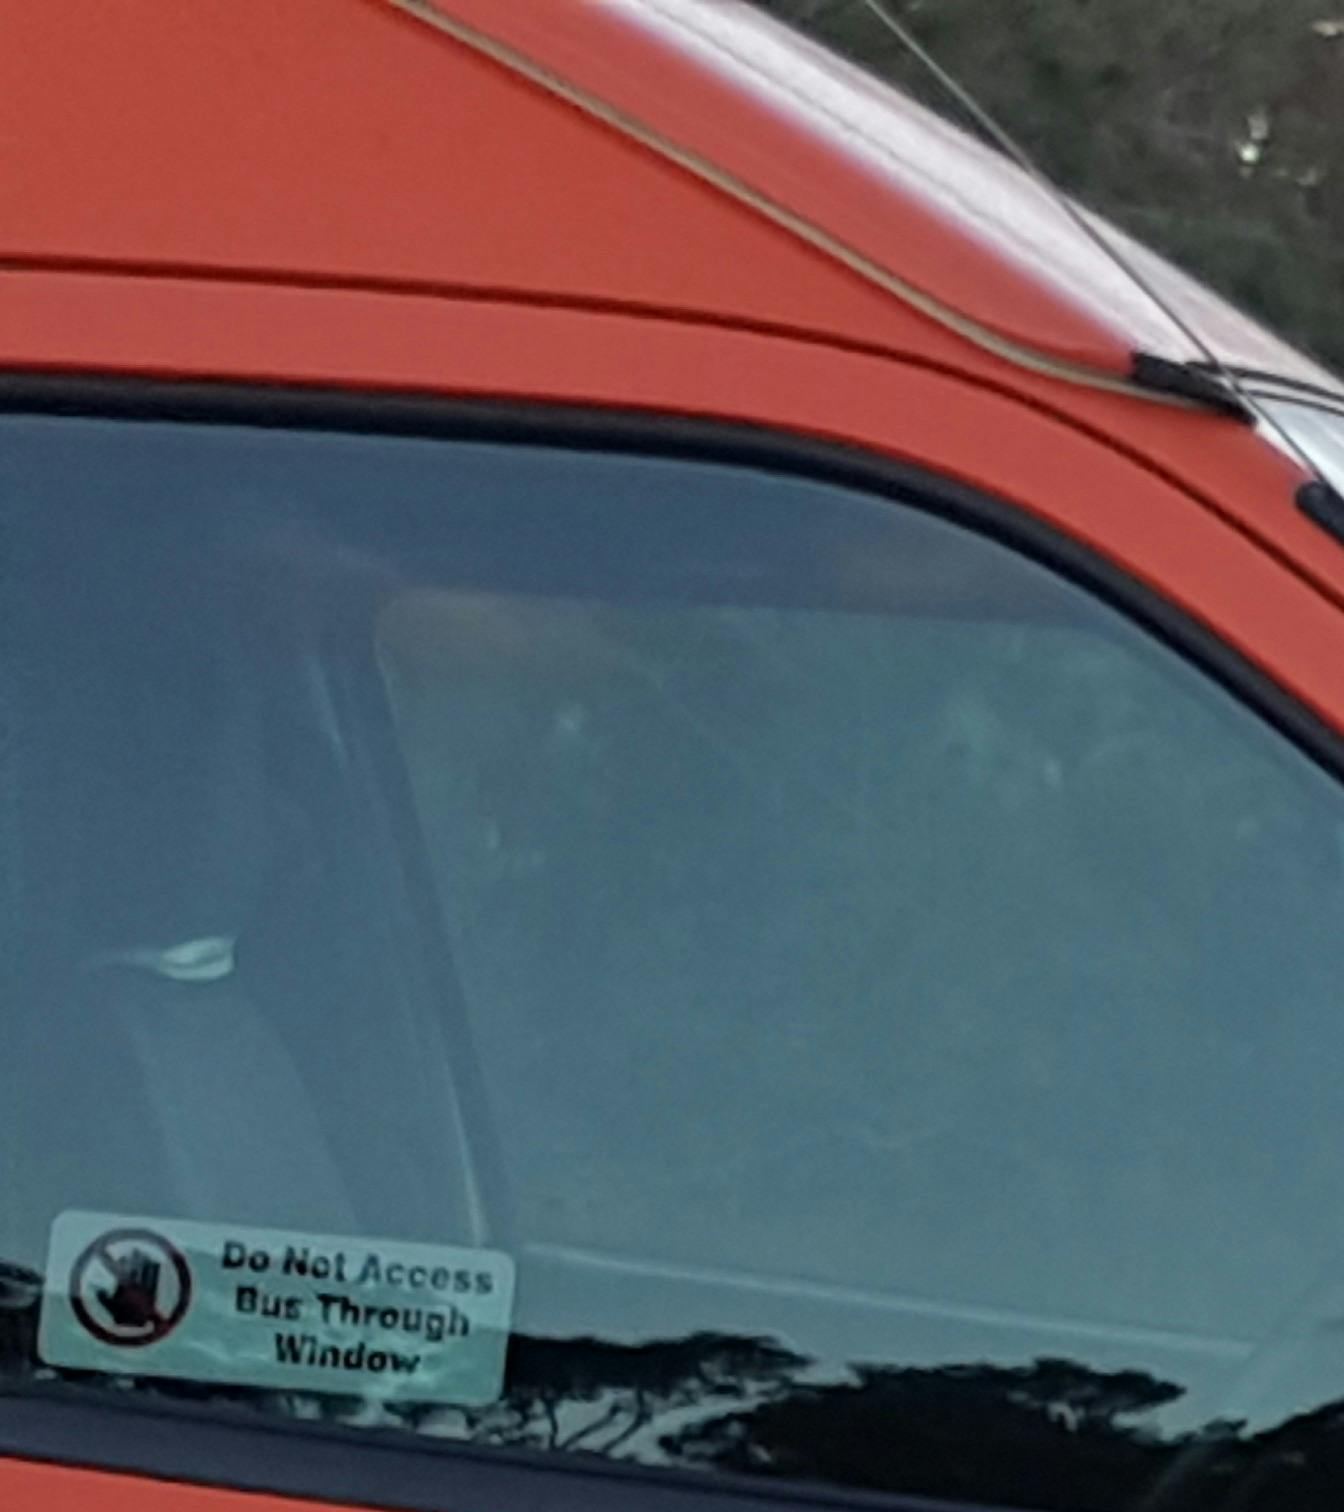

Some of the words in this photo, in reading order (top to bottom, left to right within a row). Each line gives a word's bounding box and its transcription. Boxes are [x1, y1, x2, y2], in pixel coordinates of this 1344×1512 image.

[221, 1241, 271, 1270] Do
[282, 1245, 347, 1281] Not
[359, 1254, 494, 1294] Access
[235, 1286, 301, 1320] Bus
[317, 1293, 470, 1338] Through
[274, 1334, 421, 1374] Window
